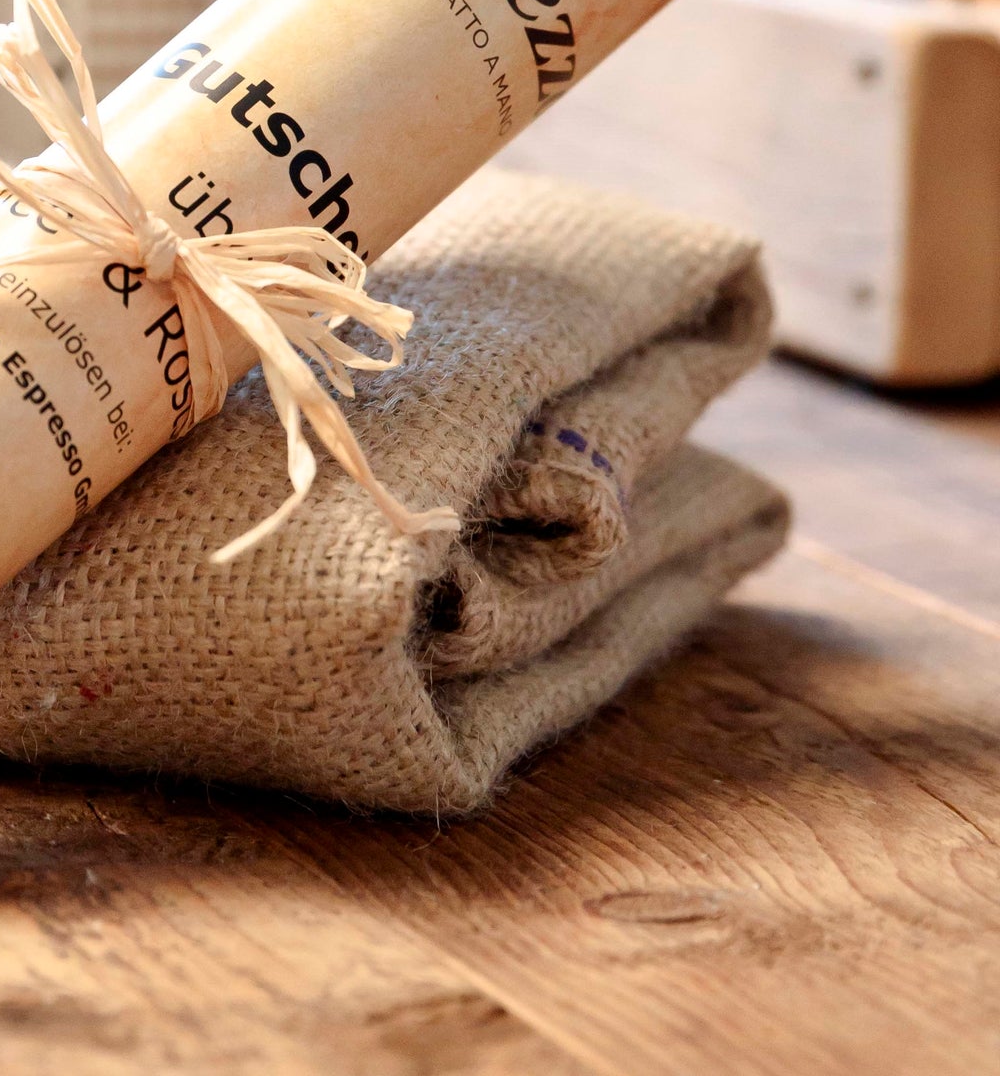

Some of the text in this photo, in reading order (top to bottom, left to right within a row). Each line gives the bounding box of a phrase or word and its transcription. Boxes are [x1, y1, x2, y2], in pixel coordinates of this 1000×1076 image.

[482, 55, 500, 76] A
[1, 351, 83, 477] Espresso
[106, 400, 134, 454] bei:
